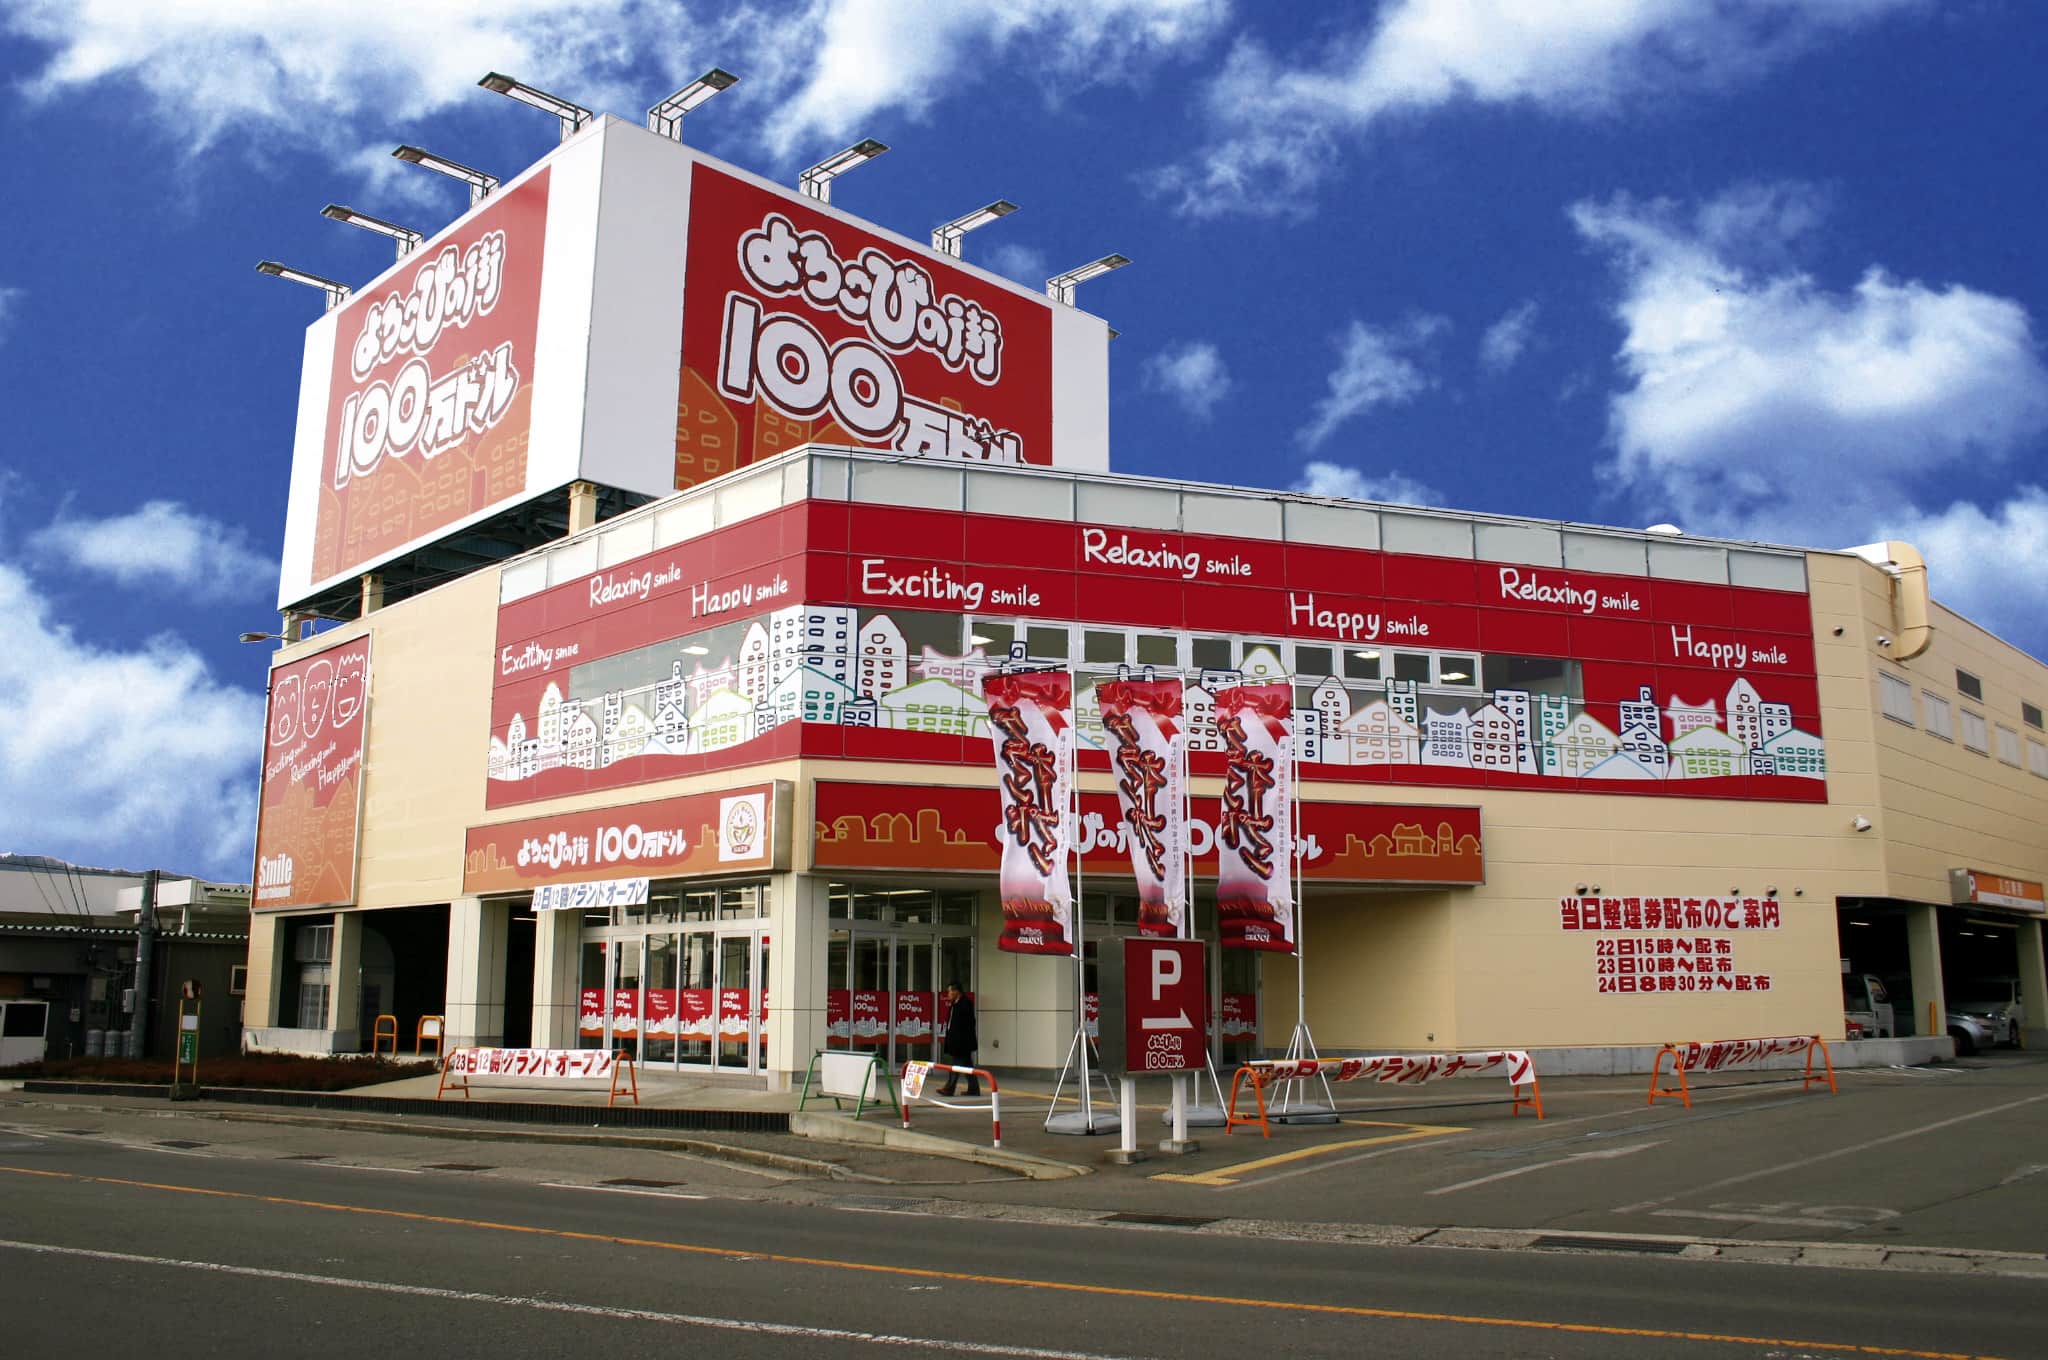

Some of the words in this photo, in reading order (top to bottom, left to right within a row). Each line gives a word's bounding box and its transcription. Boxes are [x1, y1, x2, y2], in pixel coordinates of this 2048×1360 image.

[352, 231, 505, 383] よろこびの街
[738, 213, 1003, 384] よろこびの街
[334, 341, 519, 489] 100万ドル
[1082, 528, 1200, 578] Relaxing
[1206, 554, 1252, 577] smile
[589, 571, 652, 609] Relaxing
[653, 562, 681, 586] smile
[691, 580, 752, 618] Happy
[755, 573, 788, 601] smile
[861, 559, 983, 610] Exciting
[991, 585, 1041, 608] smile
[1500, 568, 1597, 613] Relaxing
[1601, 591, 1640, 612] smile
[1289, 592, 1380, 640] Happy
[1386, 616, 1429, 637] smile
[501, 641, 553, 676] Exciting
[554, 642, 579, 661] smile
[1671, 625, 1747, 668] Happy
[1751, 645, 1788, 666] smile
[517, 831, 589, 870] よろこびの街
[594, 823, 687, 863] 100万ドル
[258, 853, 293, 888] Smile
[1561, 897, 1781, 930] 当日整理券配布のご案内
[1596, 938, 1732, 956] 22日15時～配布
[1597, 957, 1733, 974] 23日10時～配布
[1151, 949, 1182, 1001] P
[1599, 975, 1771, 993] 24日8時30分～配布
[456, 1050, 611, 1077] 23日12時グランドオープン
